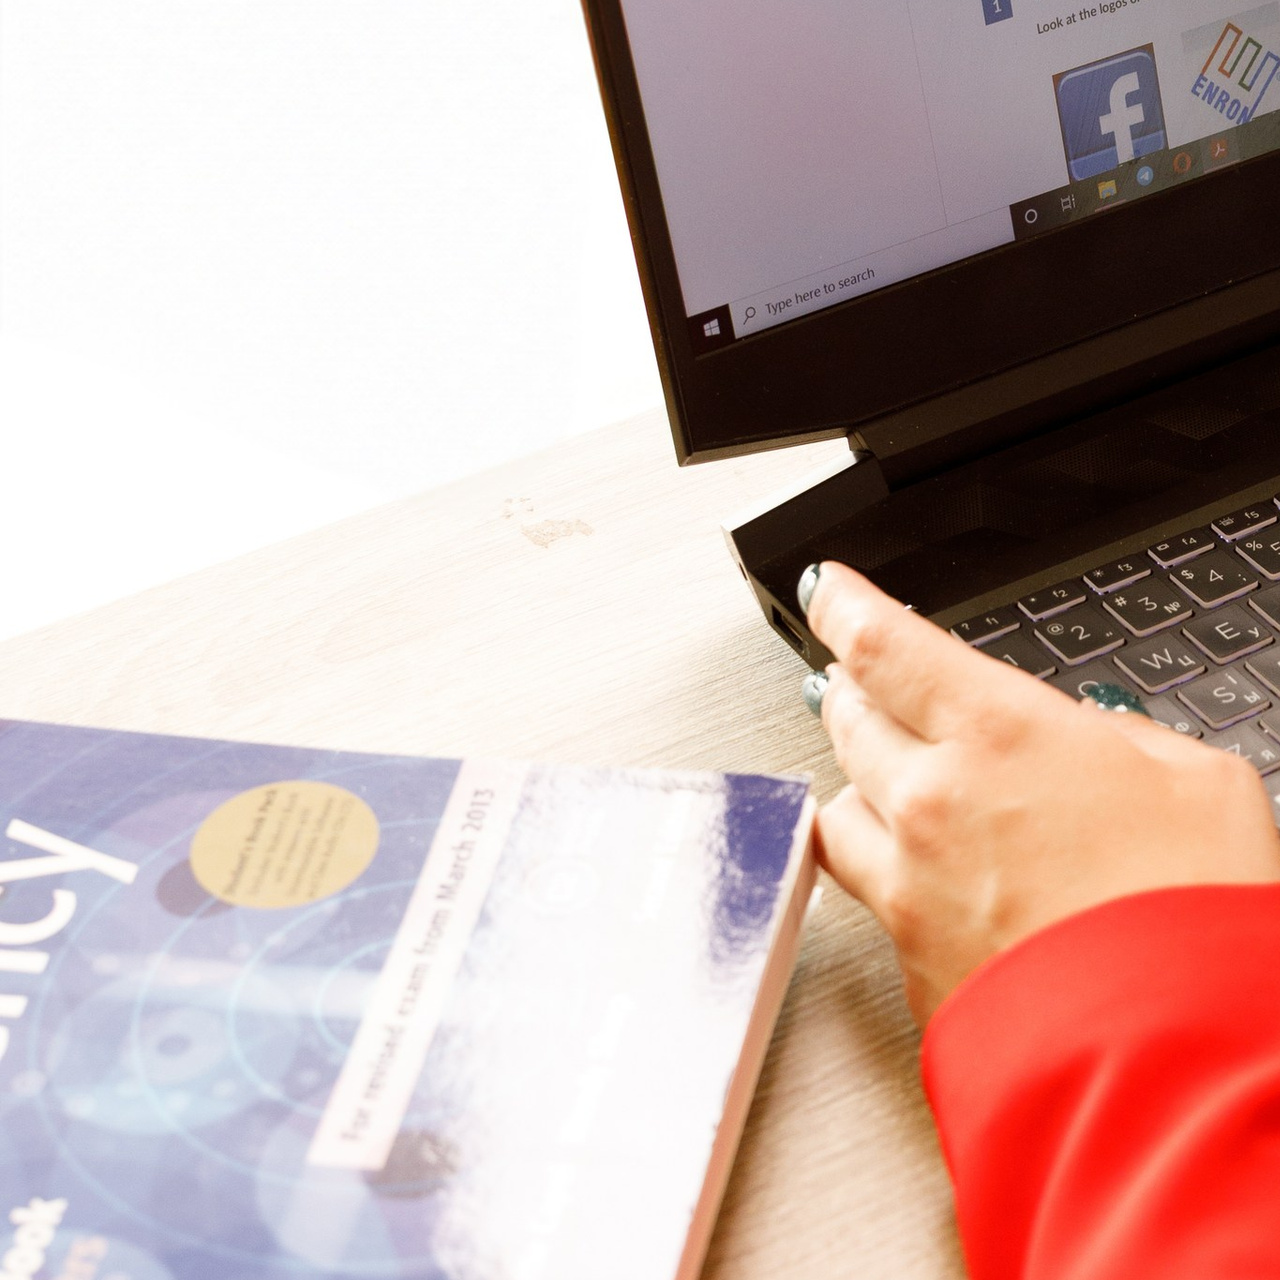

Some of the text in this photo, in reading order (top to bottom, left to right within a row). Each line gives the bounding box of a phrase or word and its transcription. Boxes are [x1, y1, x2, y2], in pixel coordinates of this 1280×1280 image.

[993, 0, 1002, 13] 1
[1037, 18, 1063, 34] Look
[1066, 15, 1077, 24] at
[1080, 8, 1097, 21] the
[1100, 0, 1127, 14] logos
[1191, 74, 1253, 124] ENRON
[765, 268, 875, 316] Type here to search
[1245, 511, 1260, 519] f5
[1182, 537, 1197, 546] f4
[1118, 563, 1133, 572] f3
[1208, 570, 1223, 582] 4
[1052, 589, 1068, 599] f2
[1138, 597, 1157, 611] 3
[986, 617, 999, 626] f1
[1071, 626, 1090, 640] 2
[1215, 622, 1240, 640] E
[1141, 648, 1174, 670] W
[1213, 687, 1235, 703] S
[413, 904, 453, 957] from
[436, 840, 475, 902] March
[460, 788, 495, 832] 2013
